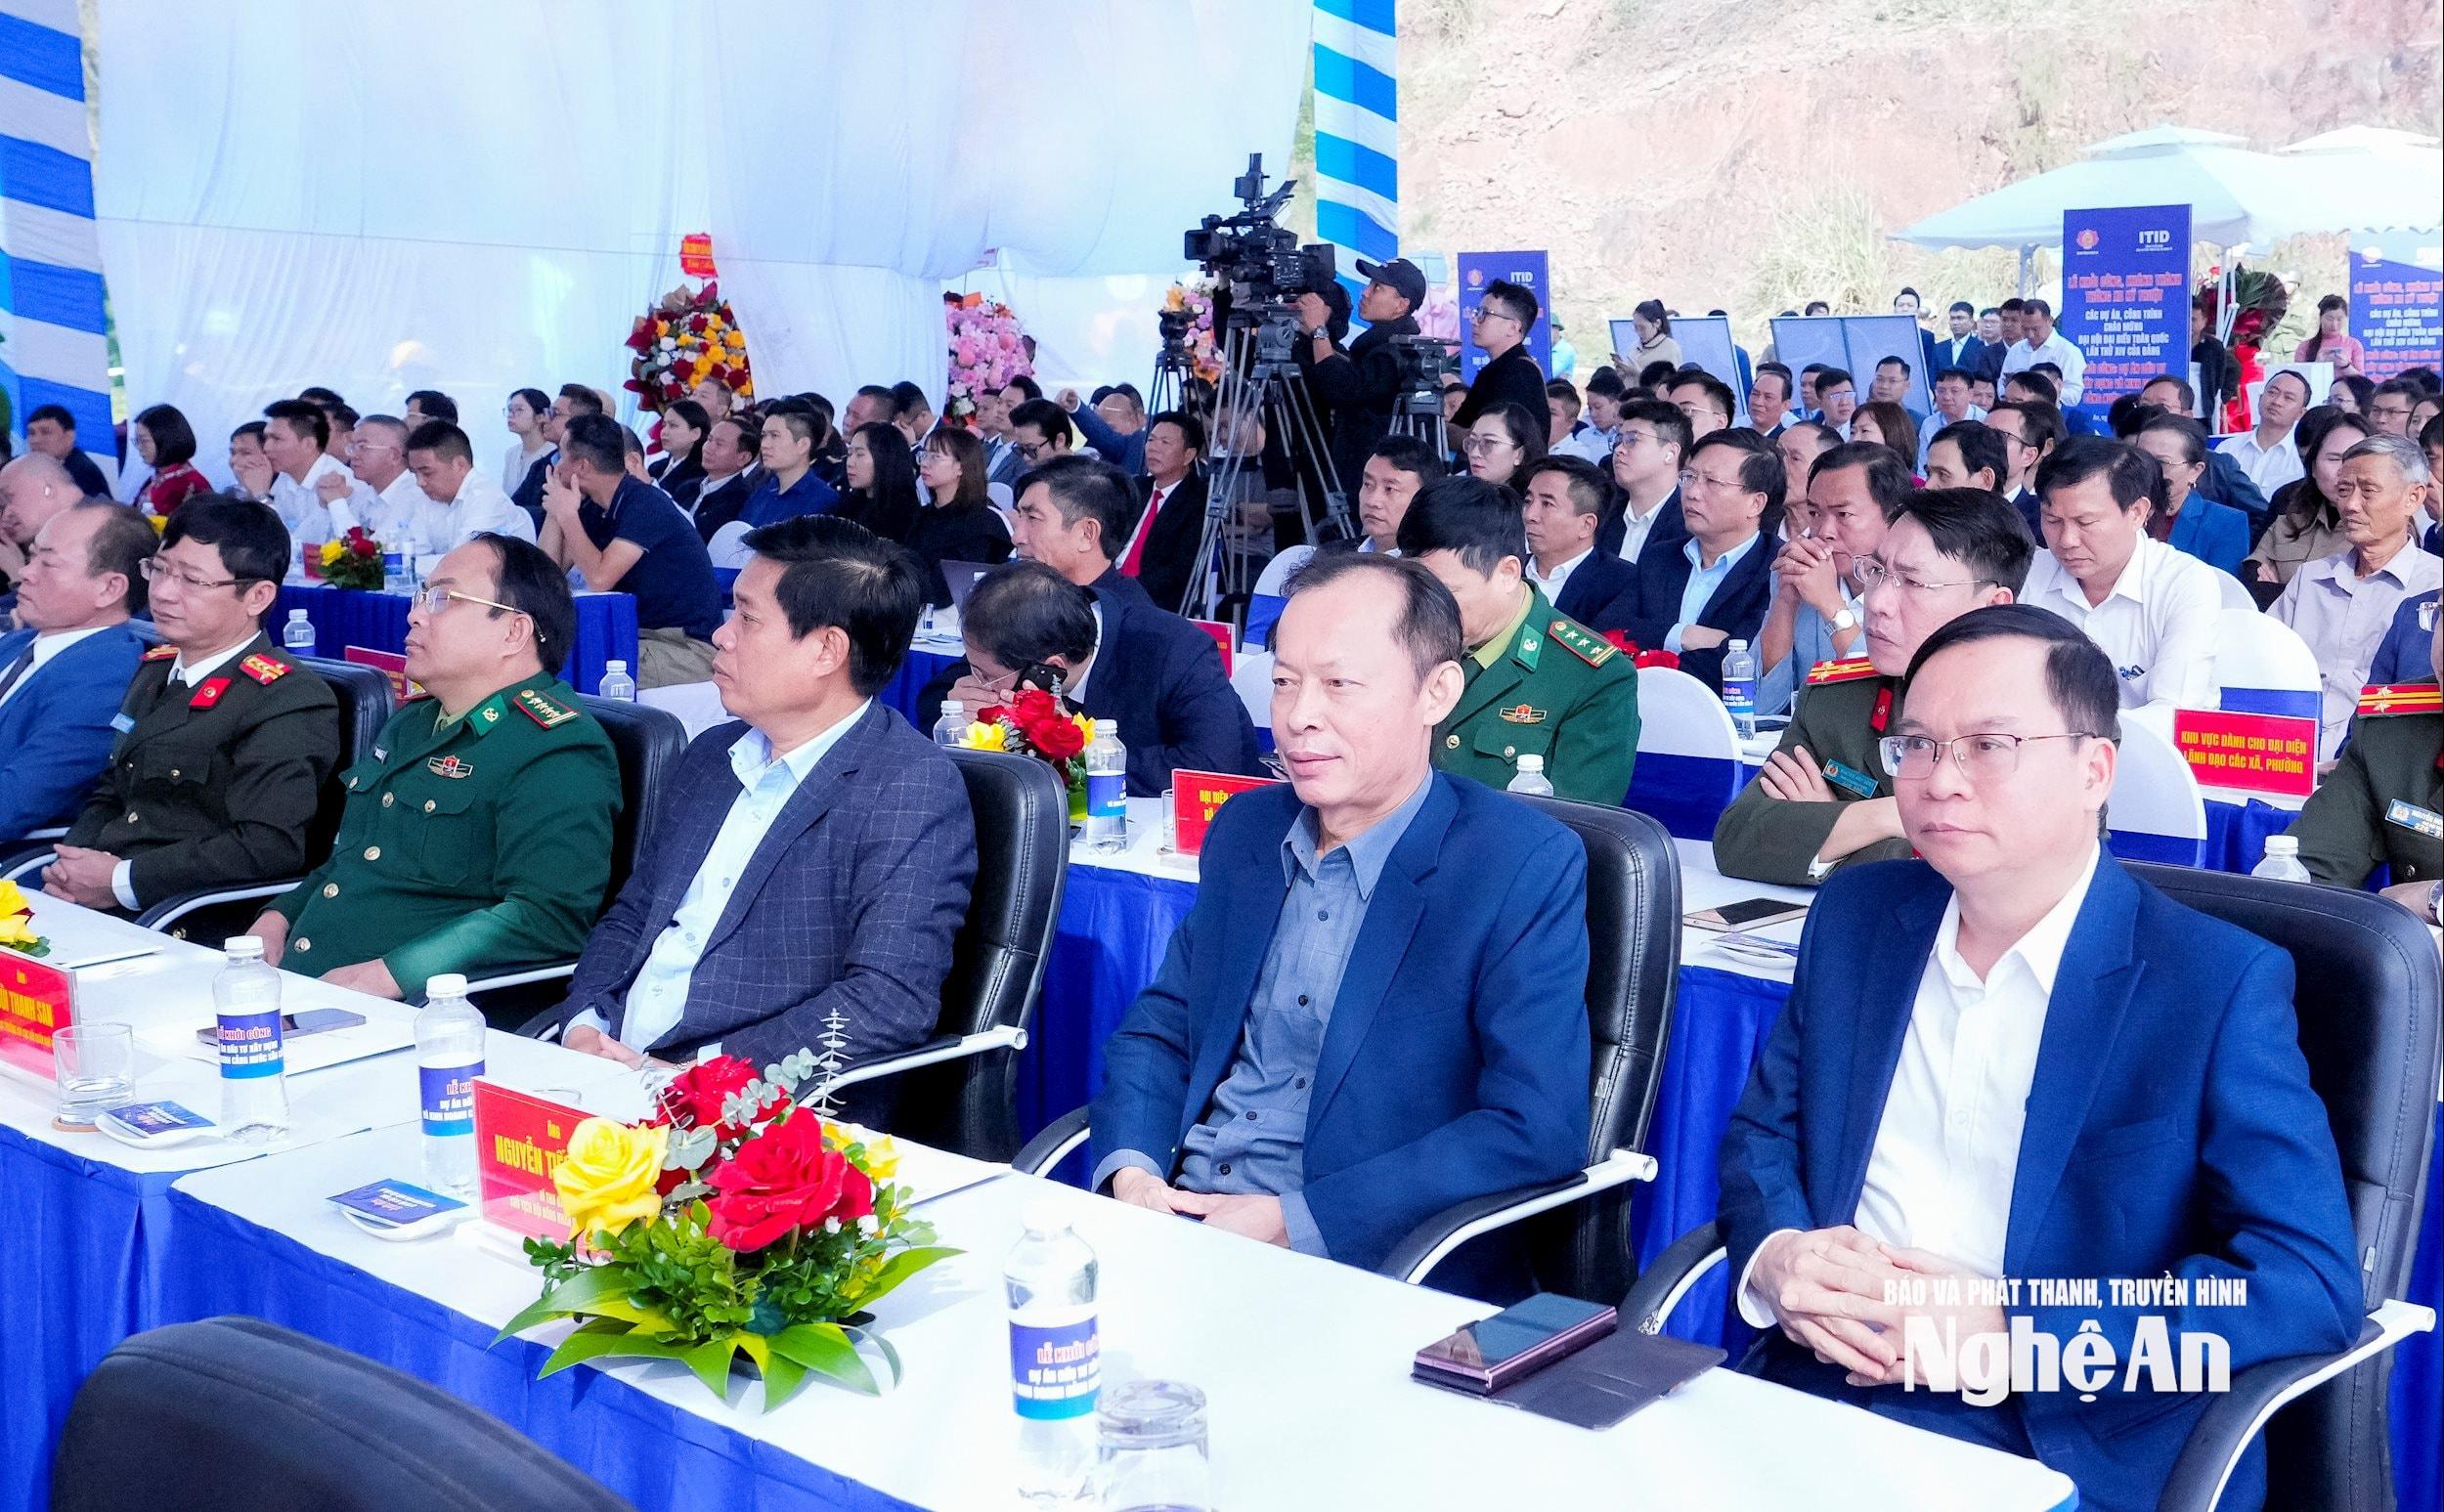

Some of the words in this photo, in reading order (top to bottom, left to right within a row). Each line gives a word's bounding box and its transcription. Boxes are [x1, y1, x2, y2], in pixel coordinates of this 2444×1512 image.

[2139, 230, 2170, 243] ITID
[1510, 271, 1533, 282] ITID
[2181, 731, 2199, 744] KHU
[2201, 732, 2219, 749] VỰC
[2221, 732, 2245, 749] DÀNH
[2248, 737, 2265, 751] CHO
[2268, 738, 2283, 755] ĐẠI
[2286, 739, 2307, 756] DIỆN
[2208, 754, 2226, 768] ĐẠO
[2229, 753, 2246, 768] CÁC
[2248, 755, 2264, 771] XÃ,
[2266, 756, 2303, 774] PHƯỜNG
[225, 1027, 245, 1040] KHỞI
[246, 1026, 272, 1040] CÔNG
[459, 1081, 472, 1094] KH
[495, 1134, 544, 1177] NGUYỄN
[545, 1148, 569, 1180] TIẾ
